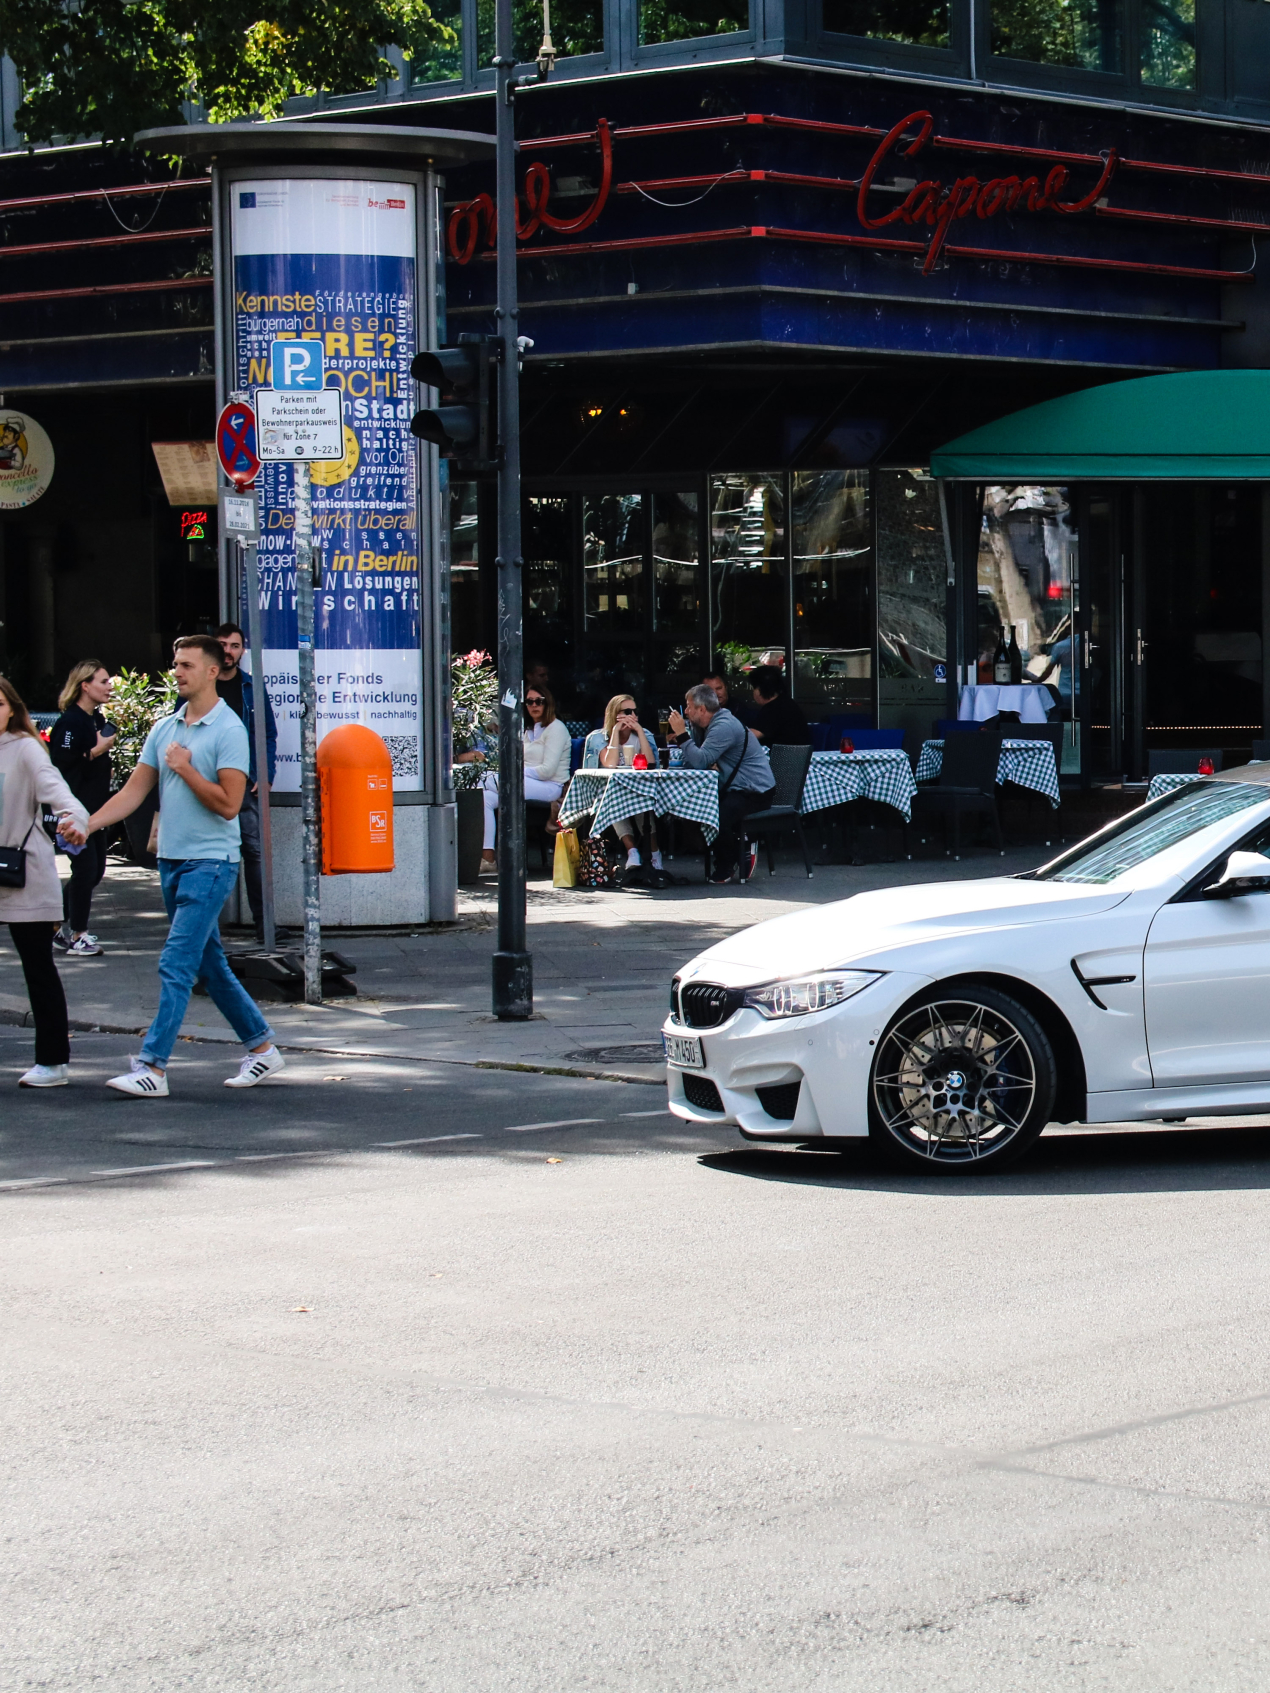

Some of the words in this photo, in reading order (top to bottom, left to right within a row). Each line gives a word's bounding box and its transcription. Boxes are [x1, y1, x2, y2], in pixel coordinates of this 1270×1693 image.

[449, 117, 613, 266] one
[858, 110, 1117, 276] Capone
[236, 291, 316, 313] Kennste
[316, 296, 397, 314] STRATEGIE
[246, 314, 302, 334] bürgernah
[303, 312, 395, 331] diesen
[246, 333, 277, 341] umwelt
[246, 341, 267, 349] sch
[277, 332, 396, 357] RE?
[396, 299, 408, 398] Entwicklung
[284, 347, 311, 385] P
[323, 356, 397, 371] derprojekte
[323, 370, 397, 397] OCH!
[280, 395, 304, 403] Parken
[306, 395, 317, 403] mit
[272, 407, 310, 415] Parkschein
[312, 407, 326, 415] oder
[354, 398, 416, 418] Stadt
[262, 418, 337, 427] Bewohnerparkausweis
[354, 420, 411, 428] entwicklun
[295, 432, 311, 440] Zone
[363, 429, 408, 438] nach
[262, 447, 285, 455] Mo-Sa
[312, 446, 332, 454] 9-22
[333, 446, 339, 454] h
[362, 439, 408, 450] haltig
[364, 451, 385, 463] vor
[388, 449, 408, 463] Ort
[360, 466, 408, 476] grenzüber
[276, 464, 287, 508] innov
[350, 475, 408, 487] greifend
[287, 485, 409, 500] poduktiv
[289, 499, 407, 511] Invationsstrategien
[268, 510, 297, 529] De
[311, 510, 353, 529] wirkt
[357, 510, 416, 529] überall
[322, 529, 416, 540] Wissen
[322, 540, 416, 549] schaft
[332, 550, 354, 571] in
[357, 550, 418, 571] Berlin
[344, 572, 418, 593] Lösungen
[258, 591, 418, 610] Wirschaft
[338, 672, 383, 684] Fonds
[332, 691, 418, 706] Entwicklung
[289, 711, 360, 719] klibewusst
[371, 710, 417, 720] nachhaltig
[371, 815, 385, 828] BSR
